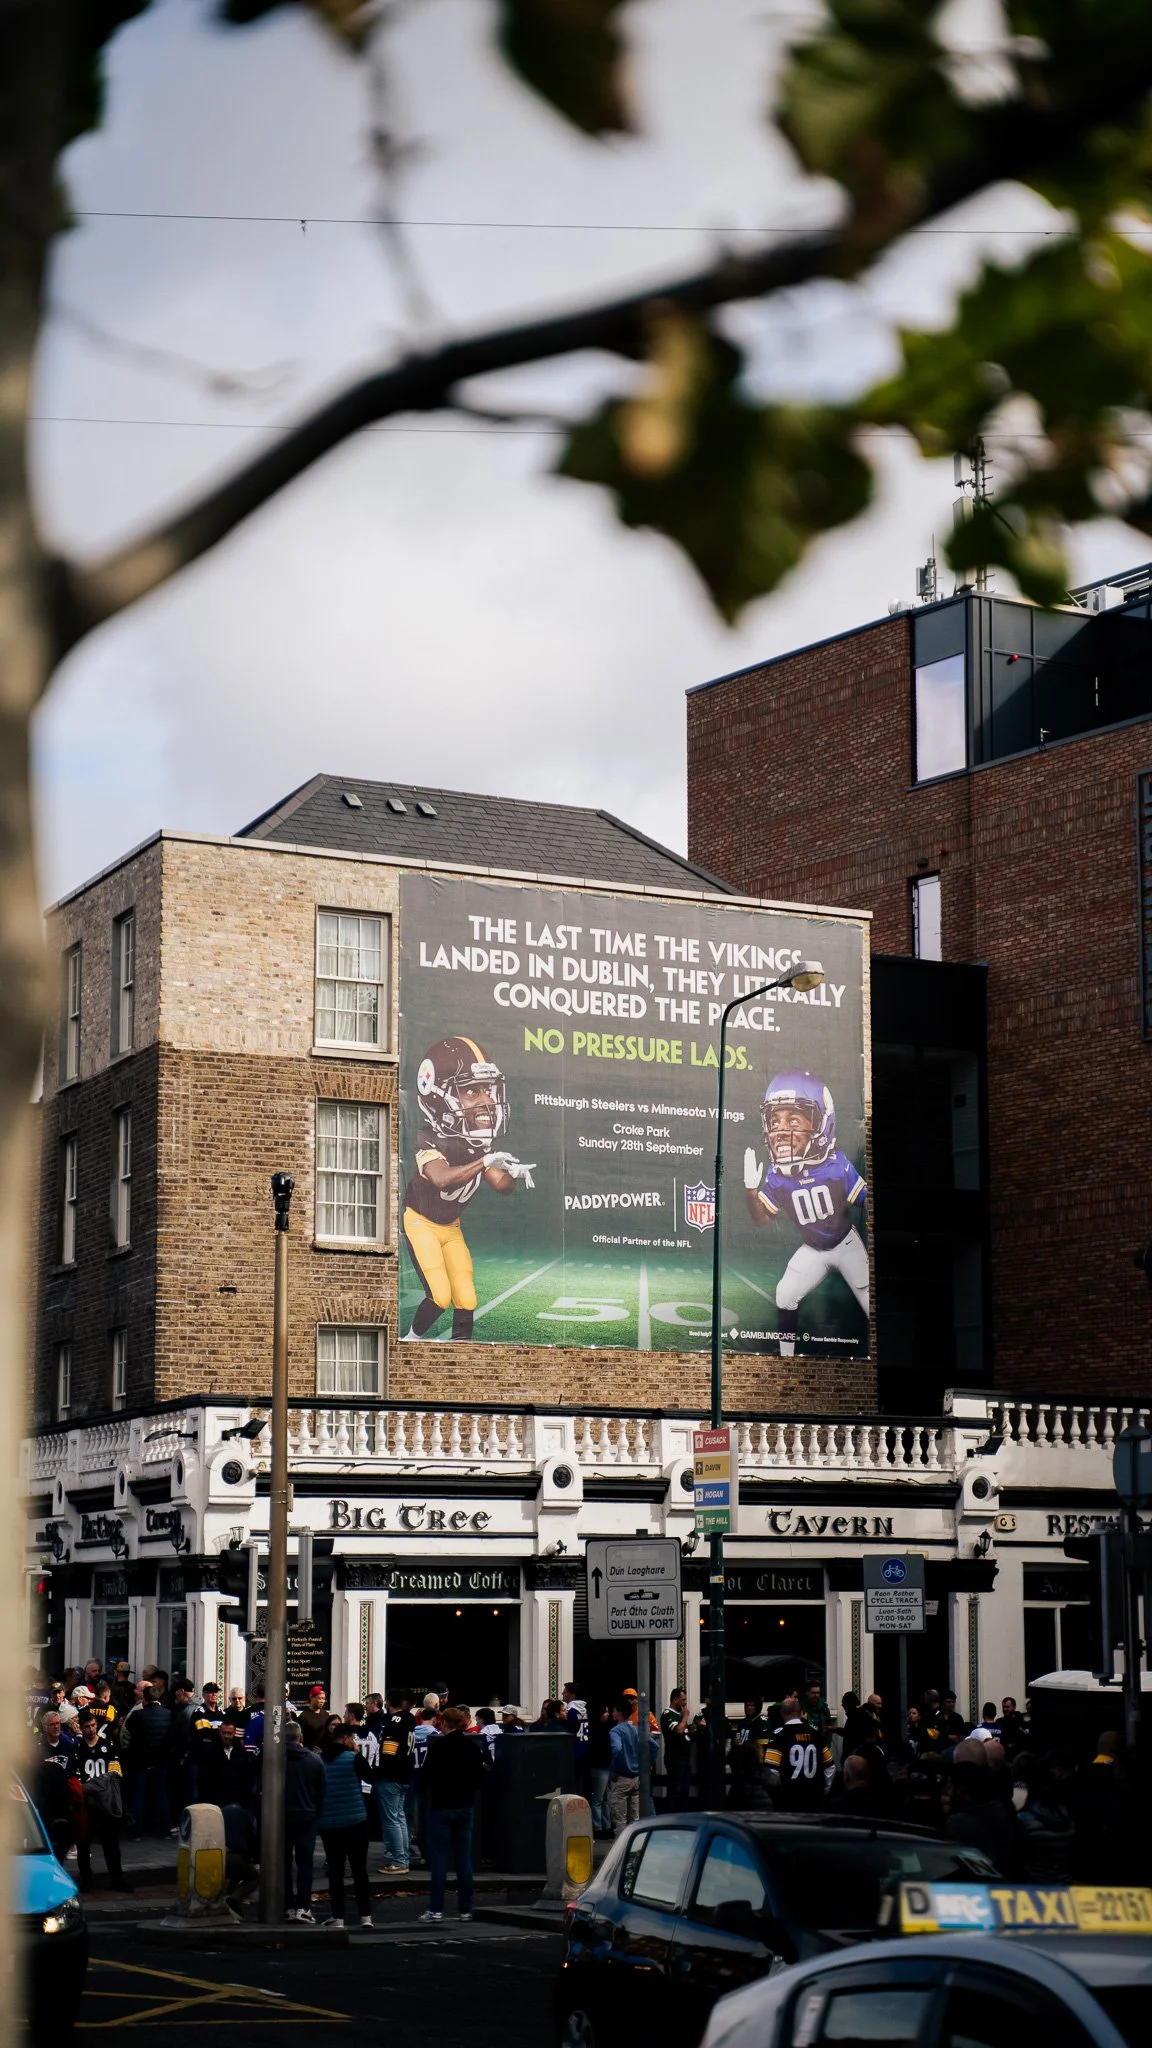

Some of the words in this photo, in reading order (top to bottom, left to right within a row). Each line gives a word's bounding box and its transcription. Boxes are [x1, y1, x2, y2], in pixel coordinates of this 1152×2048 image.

[468, 915, 517, 944] THE
[525, 921, 582, 950] LAST
[590, 928, 647, 957] TIME
[654, 935, 700, 963] THE
[420, 942, 520, 976] LANDED
[528, 953, 555, 979] IN
[562, 956, 655, 993] DUBLIN,
[663, 967, 725, 996] THEY
[493, 981, 647, 1019] CONQUERED
[654, 997, 700, 1025] THE
[708, 1002, 781, 1032] PLACE.
[524, 1026, 565, 1054] NO
[573, 1031, 683, 1065] PRESSURE
[690, 1041, 754, 1071] LADS.
[534, 1093, 589, 1110] Pittsburgh
[591, 1098, 635, 1112] Steelers
[637, 1104, 649, 1113] vs
[651, 1103, 706, 1118] Minnesota
[708, 1107, 745, 1122] Viings
[612, 1123, 645, 1136] Croke
[646, 1126, 670, 1138] Park
[578, 1137, 618, 1152] Sunday
[620, 1140, 644, 1152] 28th
[646, 1141, 704, 1156] September
[564, 1192, 662, 1210] PADDYPOWER
[791, 1184, 834, 1226] 00
[689, 1203, 714, 1223] NFL
[592, 1235, 621, 1244] Official
[622, 1236, 651, 1246] Partner
[652, 1238, 661, 1247] of
[662, 1239, 675, 1247] the
[676, 1240, 692, 1248] NFL
[705, 1436, 726, 1445] CUSACK
[705, 1490, 724, 1499] HOGAN
[705, 1517, 715, 1525] THE
[716, 1516, 728, 1525] HILL
[610, 1566, 625, 1576] Dún
[628, 1565, 665, 1576] Laoghaire
[388, 1571, 462, 1590] Creamed
[756, 1572, 813, 1592] Claret
[611, 1607, 627, 1616] Port
[651, 1606, 674, 1616] Cliath
[611, 1619, 645, 1629] DUBLIN
[649, 1618, 674, 1628] PORT
[795, 1733, 812, 1742] WATT
[789, 1744, 817, 1779] 90
[991, 1889, 1074, 1924] TAXI
